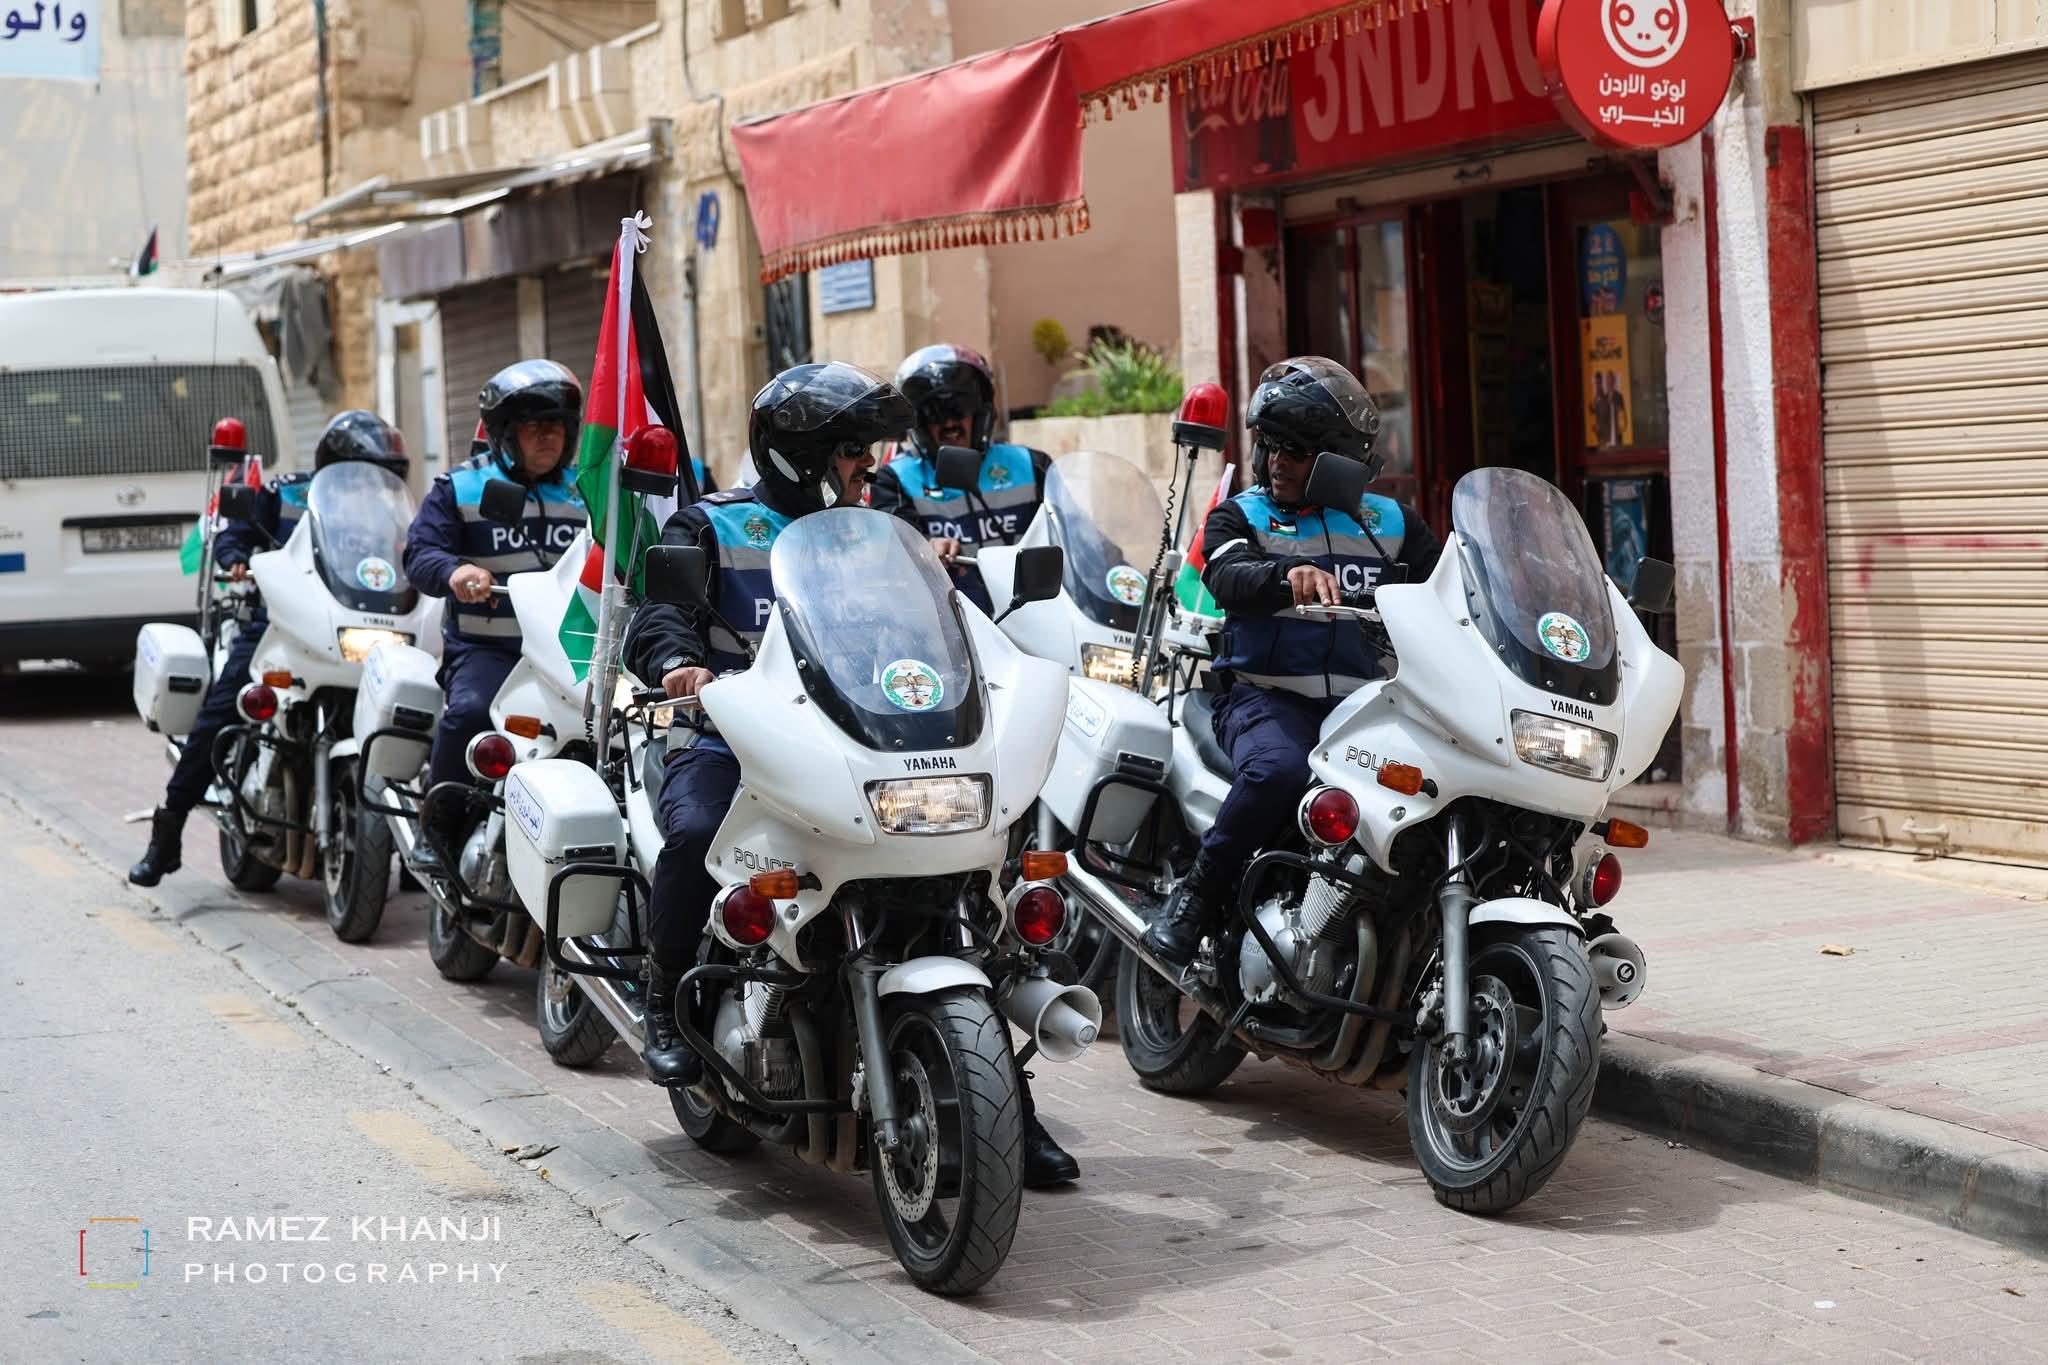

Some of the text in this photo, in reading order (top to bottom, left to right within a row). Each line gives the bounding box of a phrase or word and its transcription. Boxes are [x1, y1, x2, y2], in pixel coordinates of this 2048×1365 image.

[1650, 79, 1686, 102] لوتو
[492, 524, 583, 551] POLIC
[928, 514, 1017, 542] POLICE
[1334, 563, 1382, 592] ICE
[1113, 634, 1137, 646] YAM
[1550, 699, 1594, 721] YAMAHA
[903, 756, 957, 771] YAMAHA
